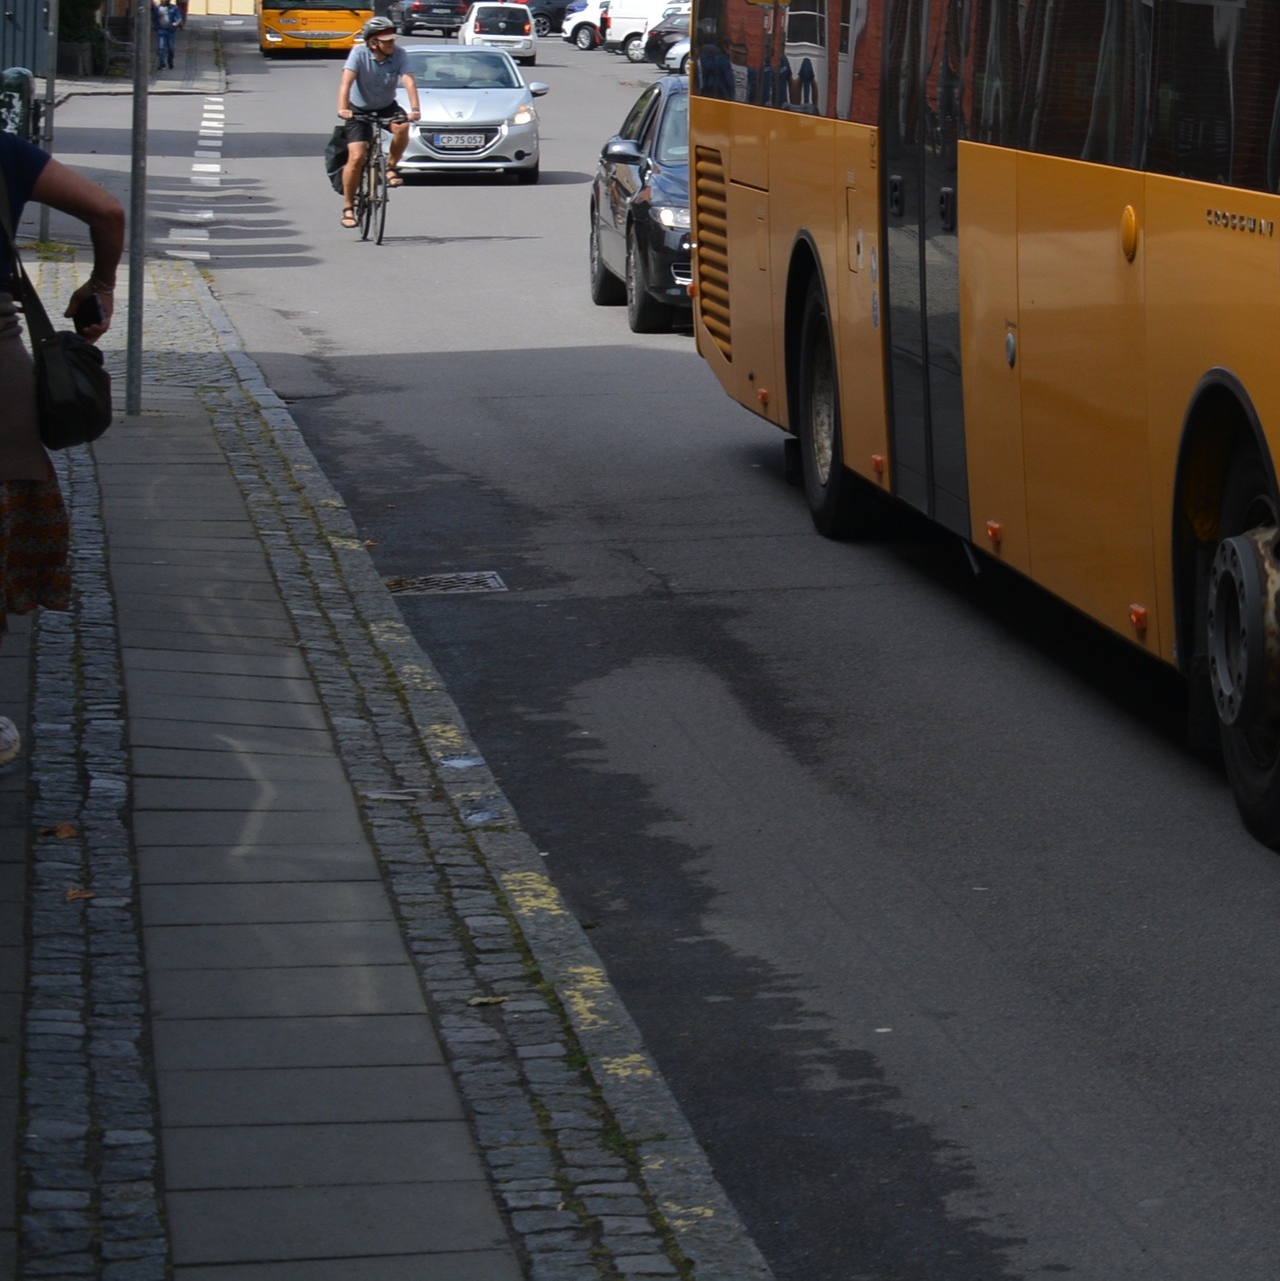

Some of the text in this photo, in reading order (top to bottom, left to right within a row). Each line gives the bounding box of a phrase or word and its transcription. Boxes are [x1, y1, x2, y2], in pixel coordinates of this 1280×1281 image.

[441, 136, 483, 144] CP 75 057
